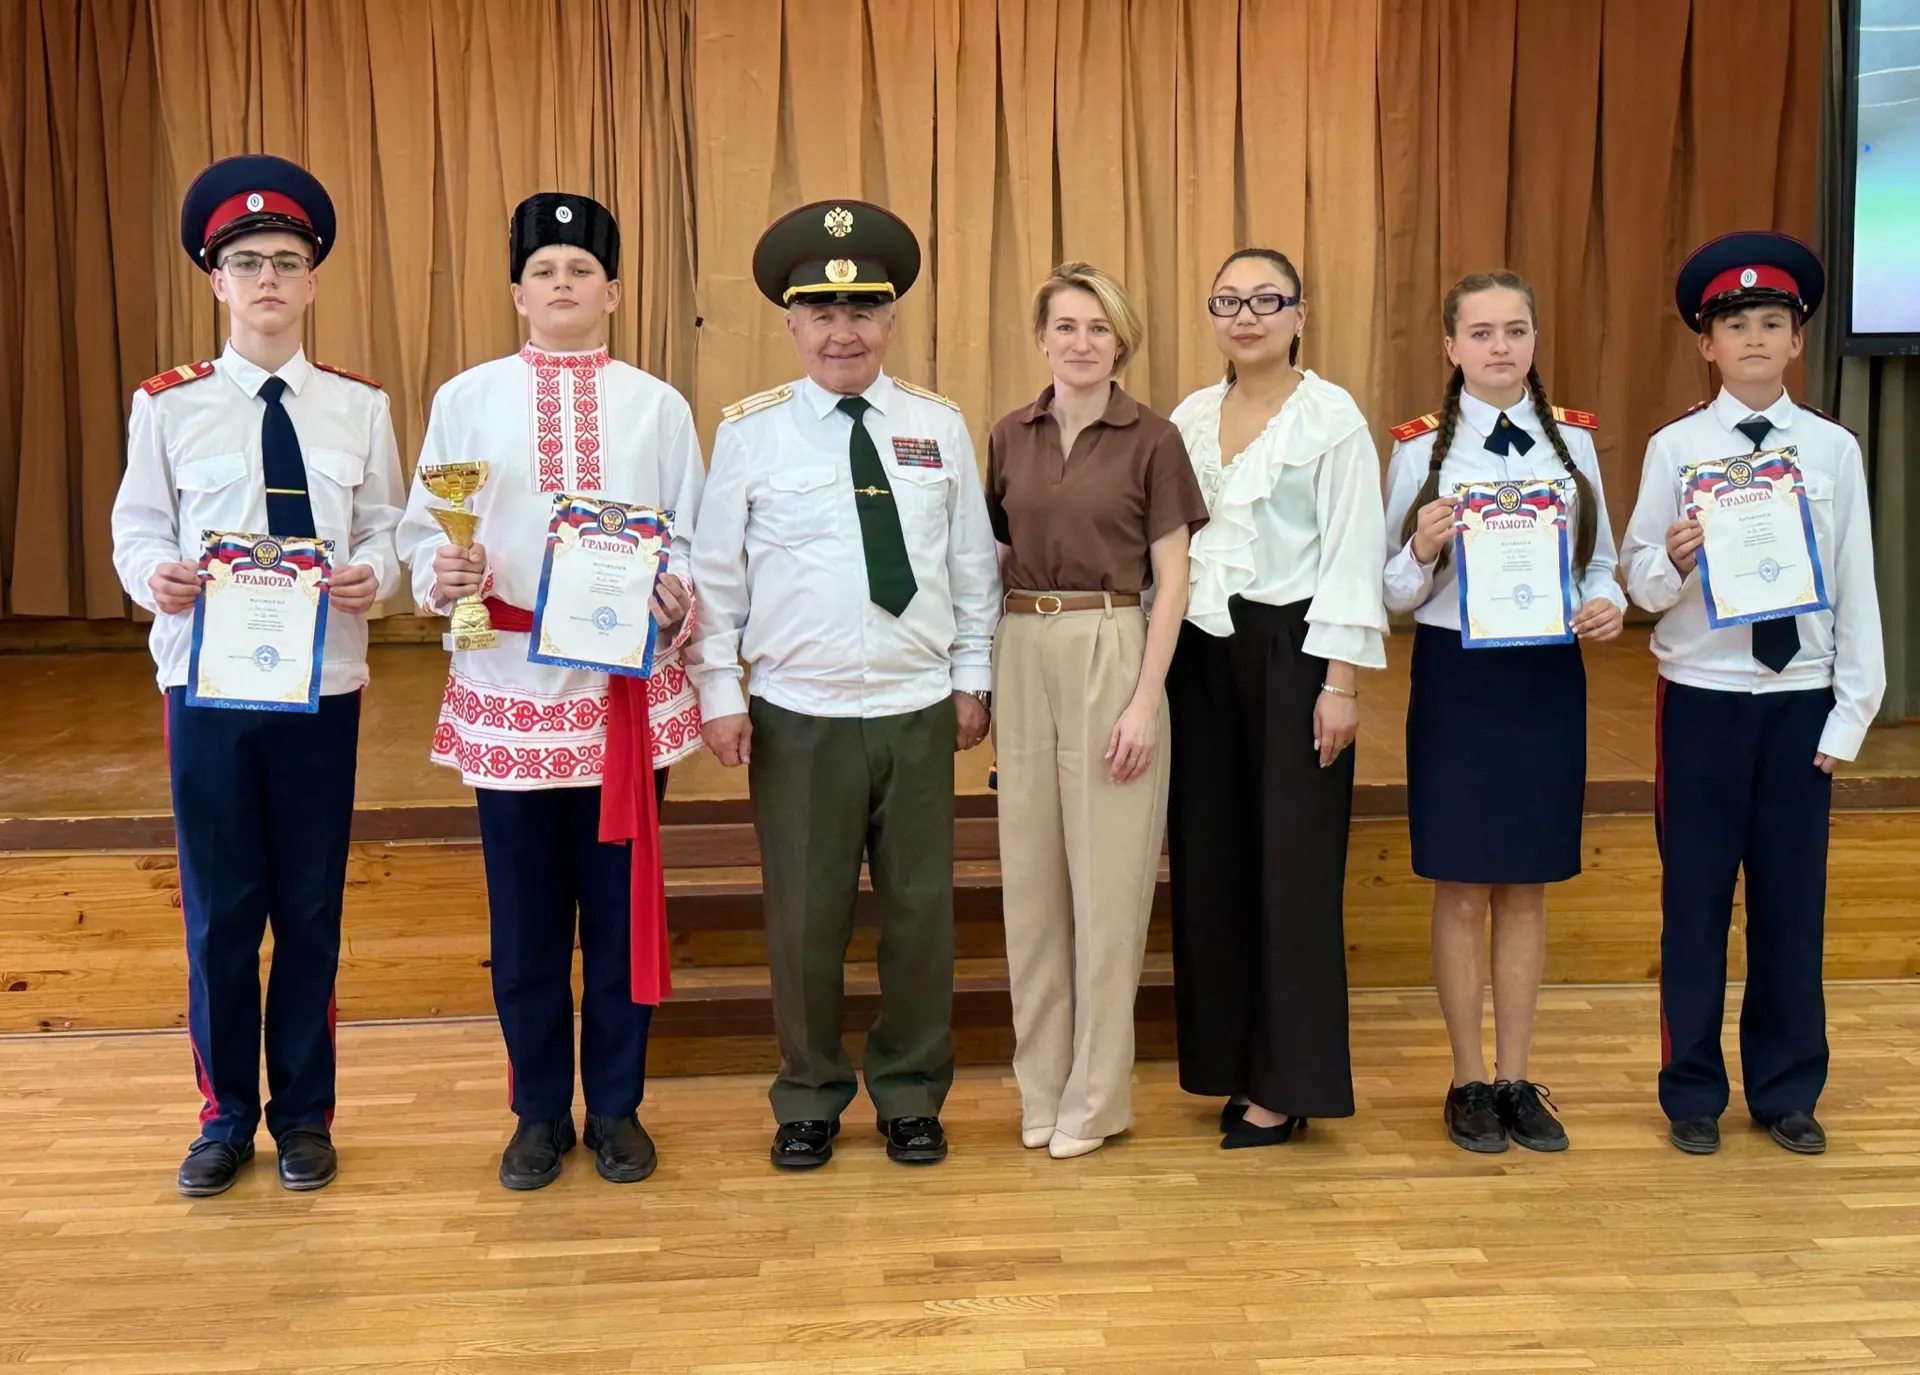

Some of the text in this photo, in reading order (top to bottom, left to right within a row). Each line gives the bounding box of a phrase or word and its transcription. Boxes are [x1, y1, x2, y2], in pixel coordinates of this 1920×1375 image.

[1718, 490, 1772, 508] ГРАМОТА
[1486, 520, 1535, 530] ГРАМОТА
[581, 538, 634, 555] ГРАМОТА
[234, 573, 293, 587] ГРАМОТА
